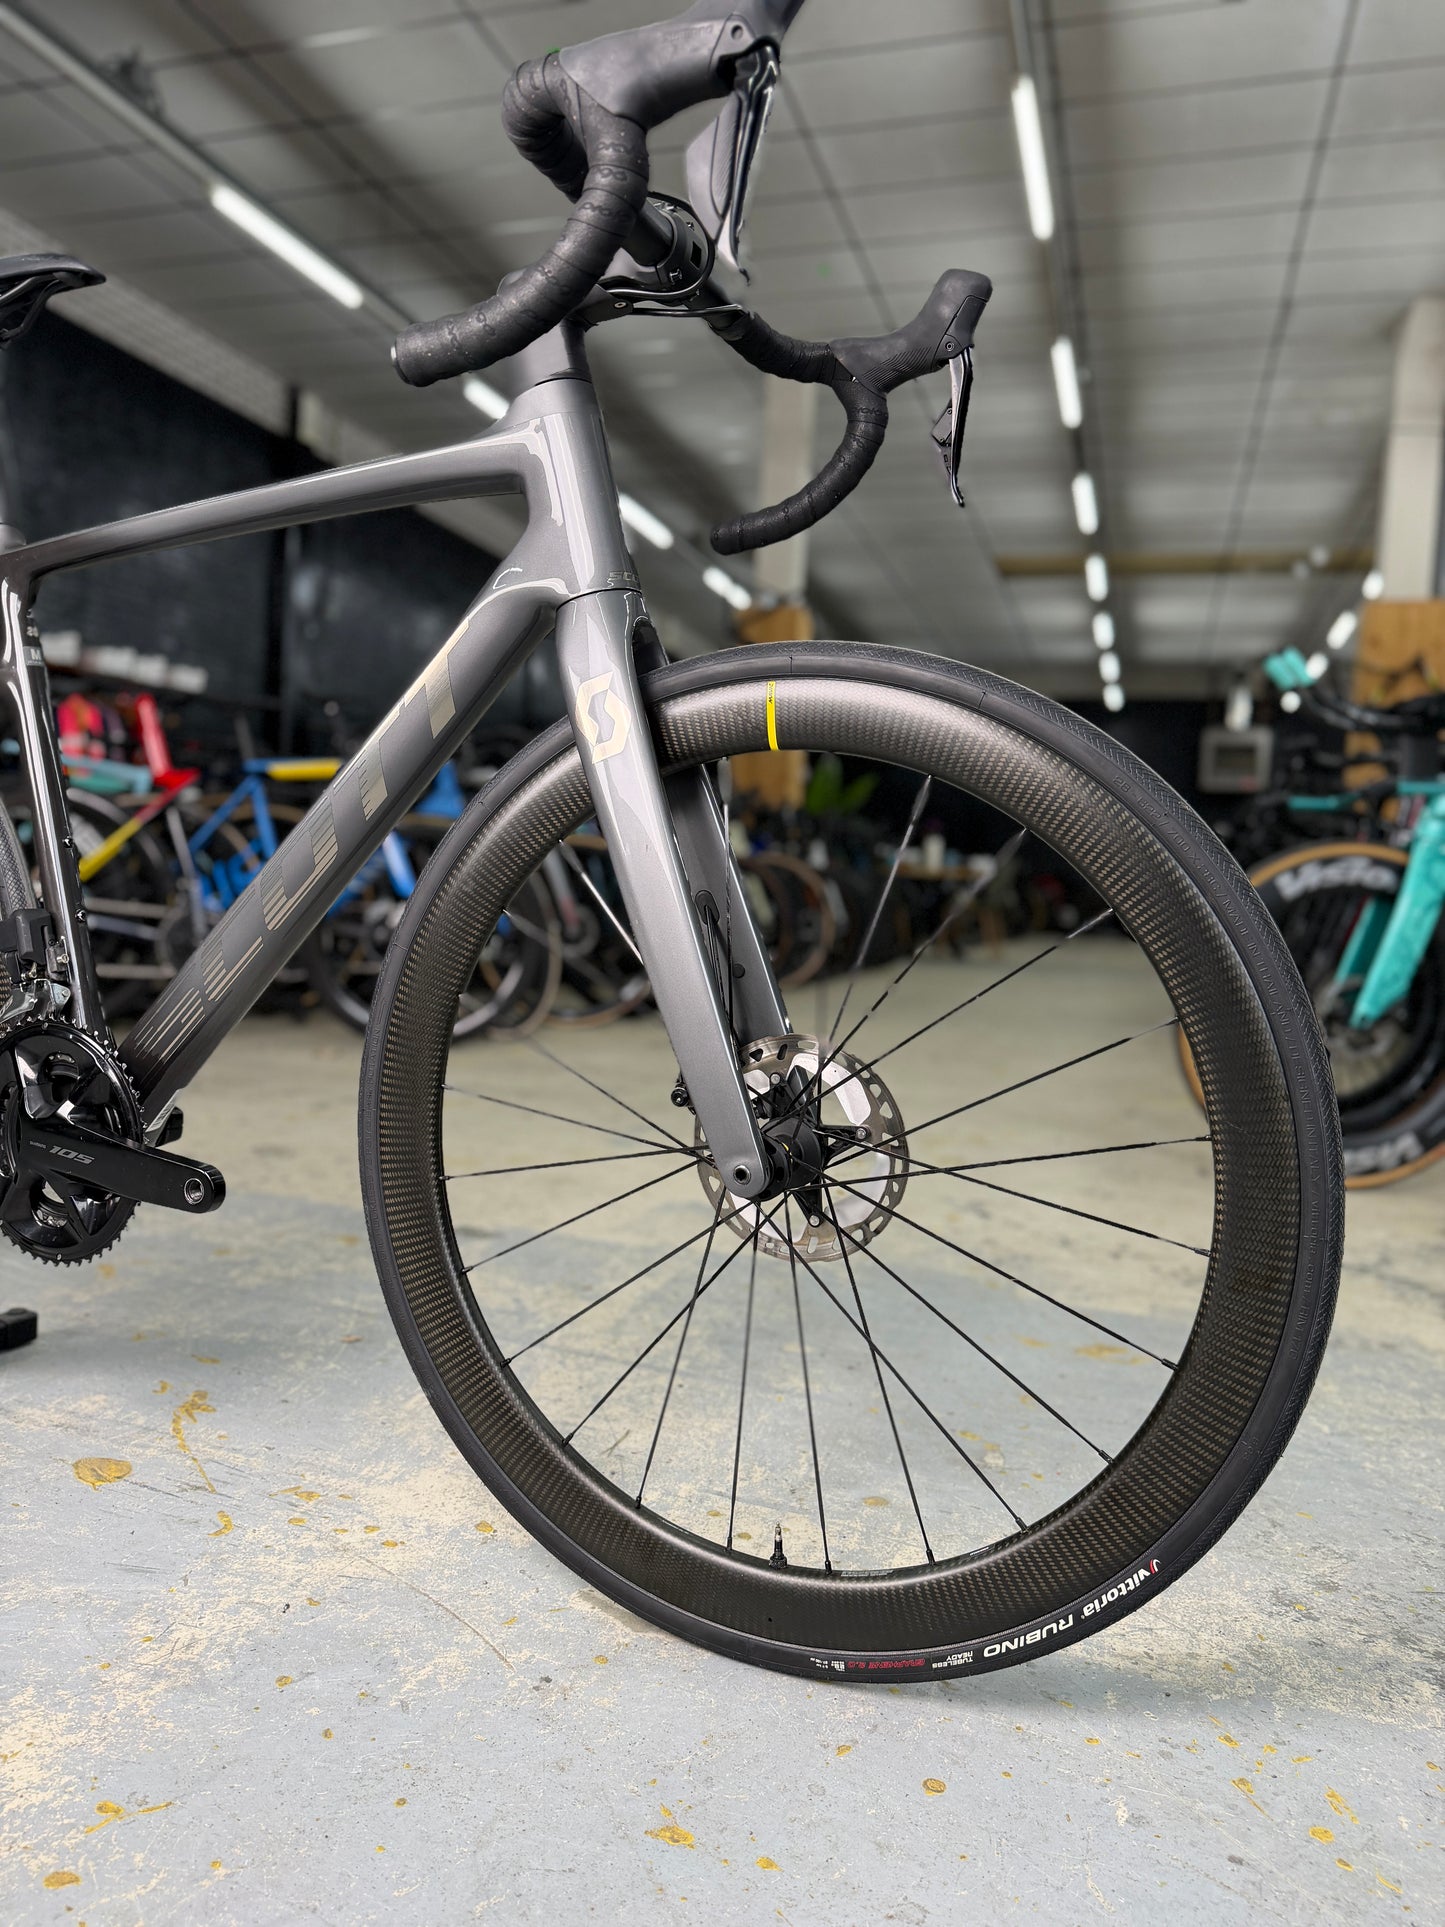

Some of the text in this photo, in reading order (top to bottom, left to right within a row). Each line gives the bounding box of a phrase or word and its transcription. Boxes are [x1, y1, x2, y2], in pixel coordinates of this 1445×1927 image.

[49, 1145, 95, 1165] 105
[983, 1568, 1151, 1658] vittoria RUBINO
[932, 1656, 973, 1668] TUBELESS
[946, 1650, 973, 1662] READY
